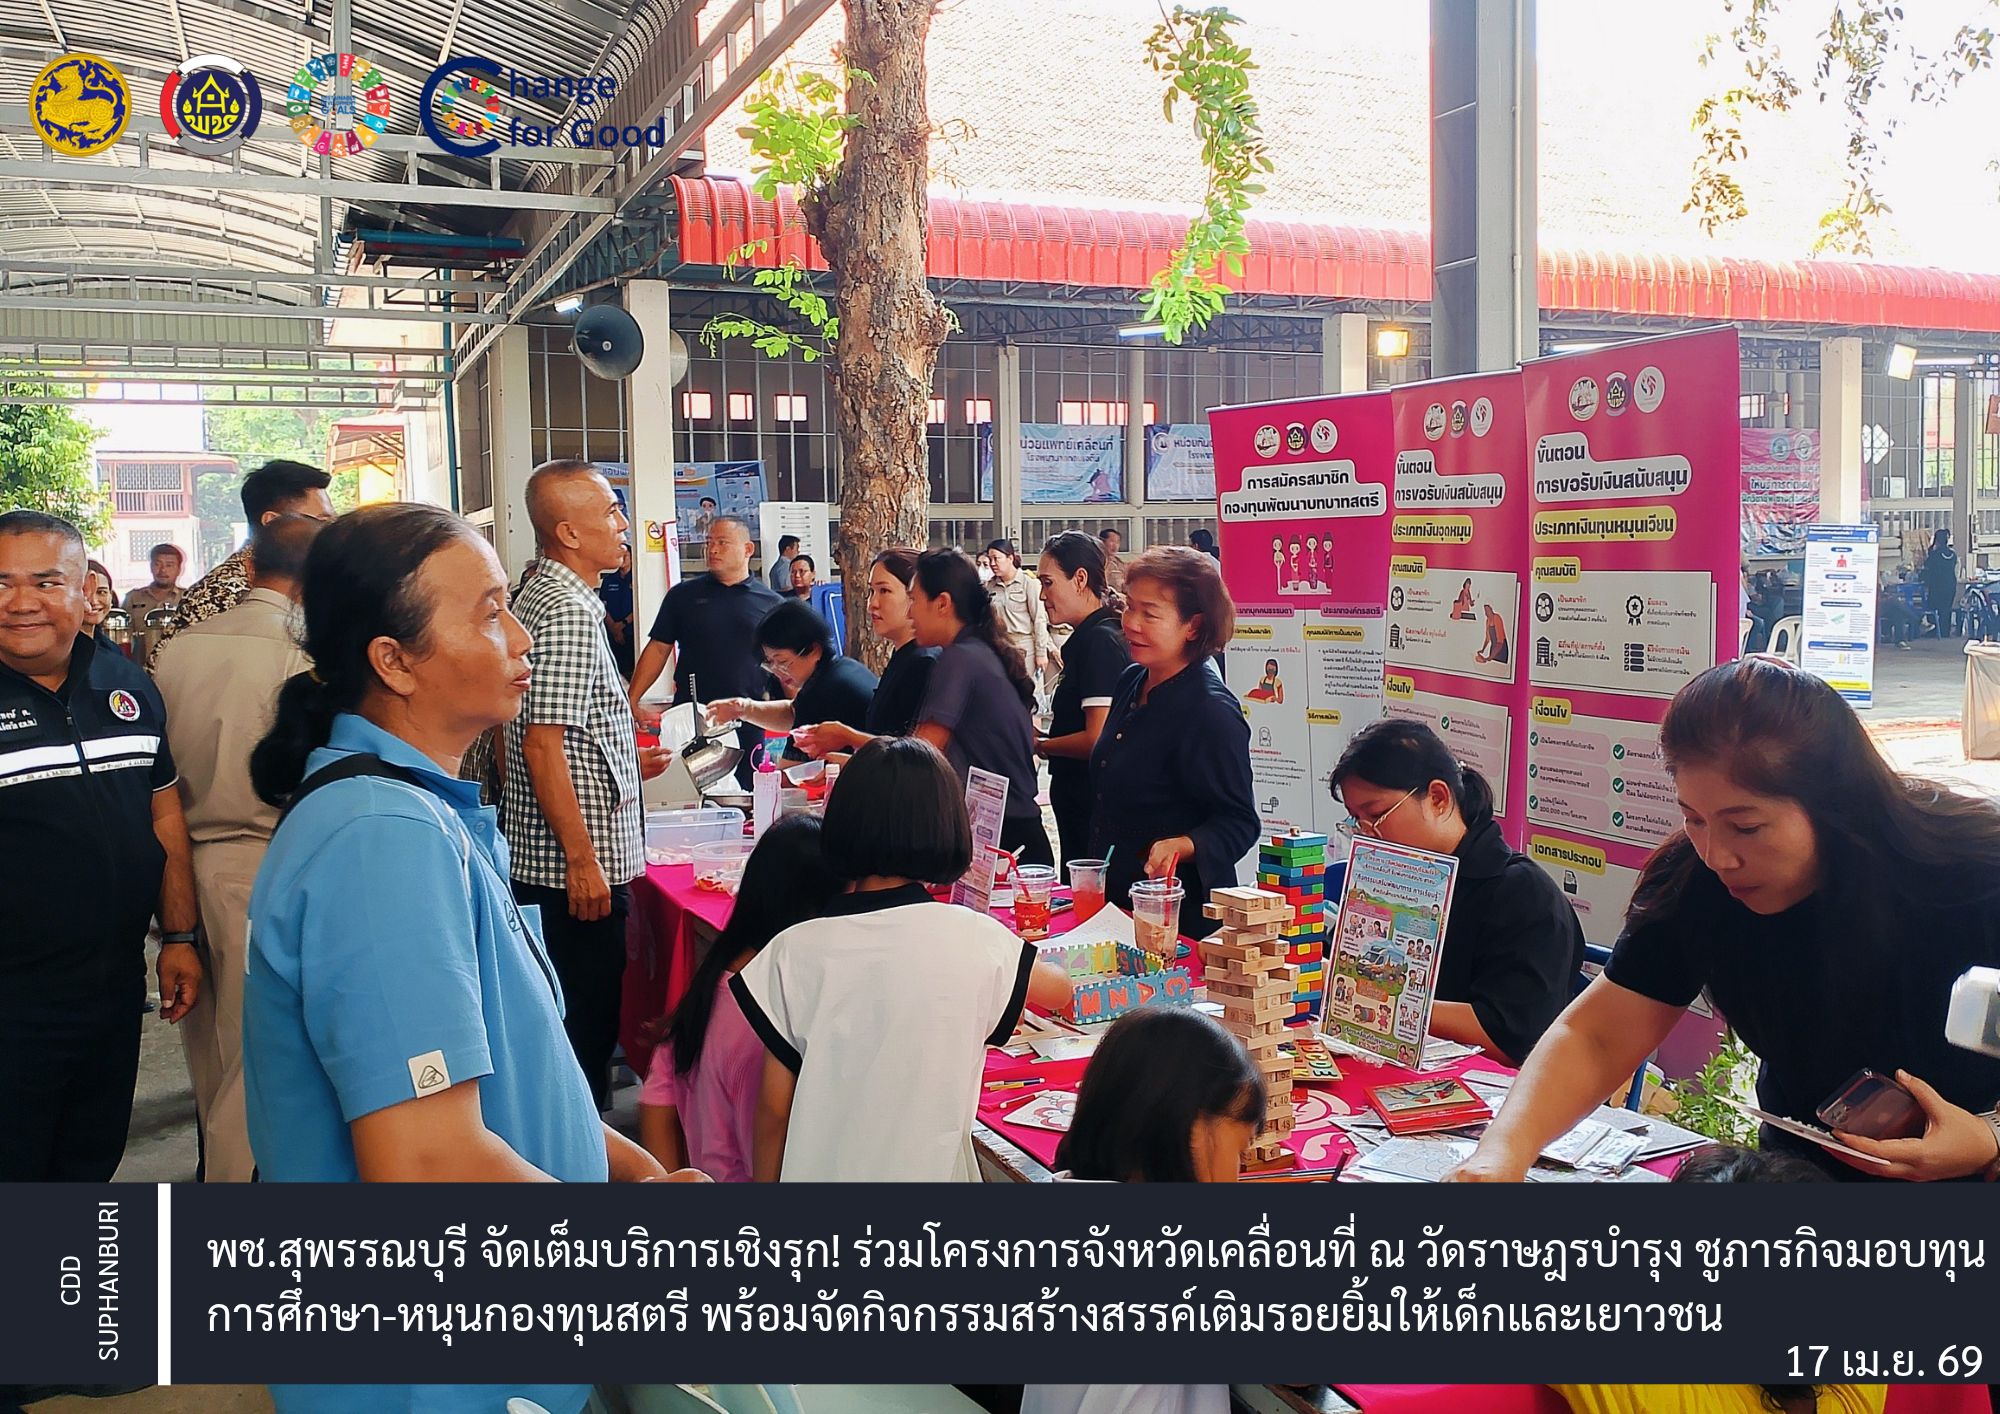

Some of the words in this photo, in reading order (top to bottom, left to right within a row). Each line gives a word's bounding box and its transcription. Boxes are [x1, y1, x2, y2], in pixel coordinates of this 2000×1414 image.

[1019, 435, 1114, 451] น่วยแพทย์เคลื่อนที่
[1537, 439, 1585, 463] ขั้นตอน
[1397, 454, 1432, 475] ขั้นตอน
[1247, 469, 1349, 490] การสมัครสมาชิก
[1536, 467, 1688, 494] การขอรับเงินสนับสนุน
[1224, 491, 1380, 517] กองทุนพัฒนาบทบาทสตรี
[1395, 482, 1503, 505] การขอรับเงินสนับสนุน
[1535, 514, 1674, 539] ประเภทเงินทุนหมุนเวียน
[1392, 562, 1423, 576] คุณสมบัติ
[1535, 563, 1577, 580] คุณสมบัติ
[1535, 701, 1568, 719] เงื่อนไข
[1534, 843, 1602, 868] เอกสารประกอบ
